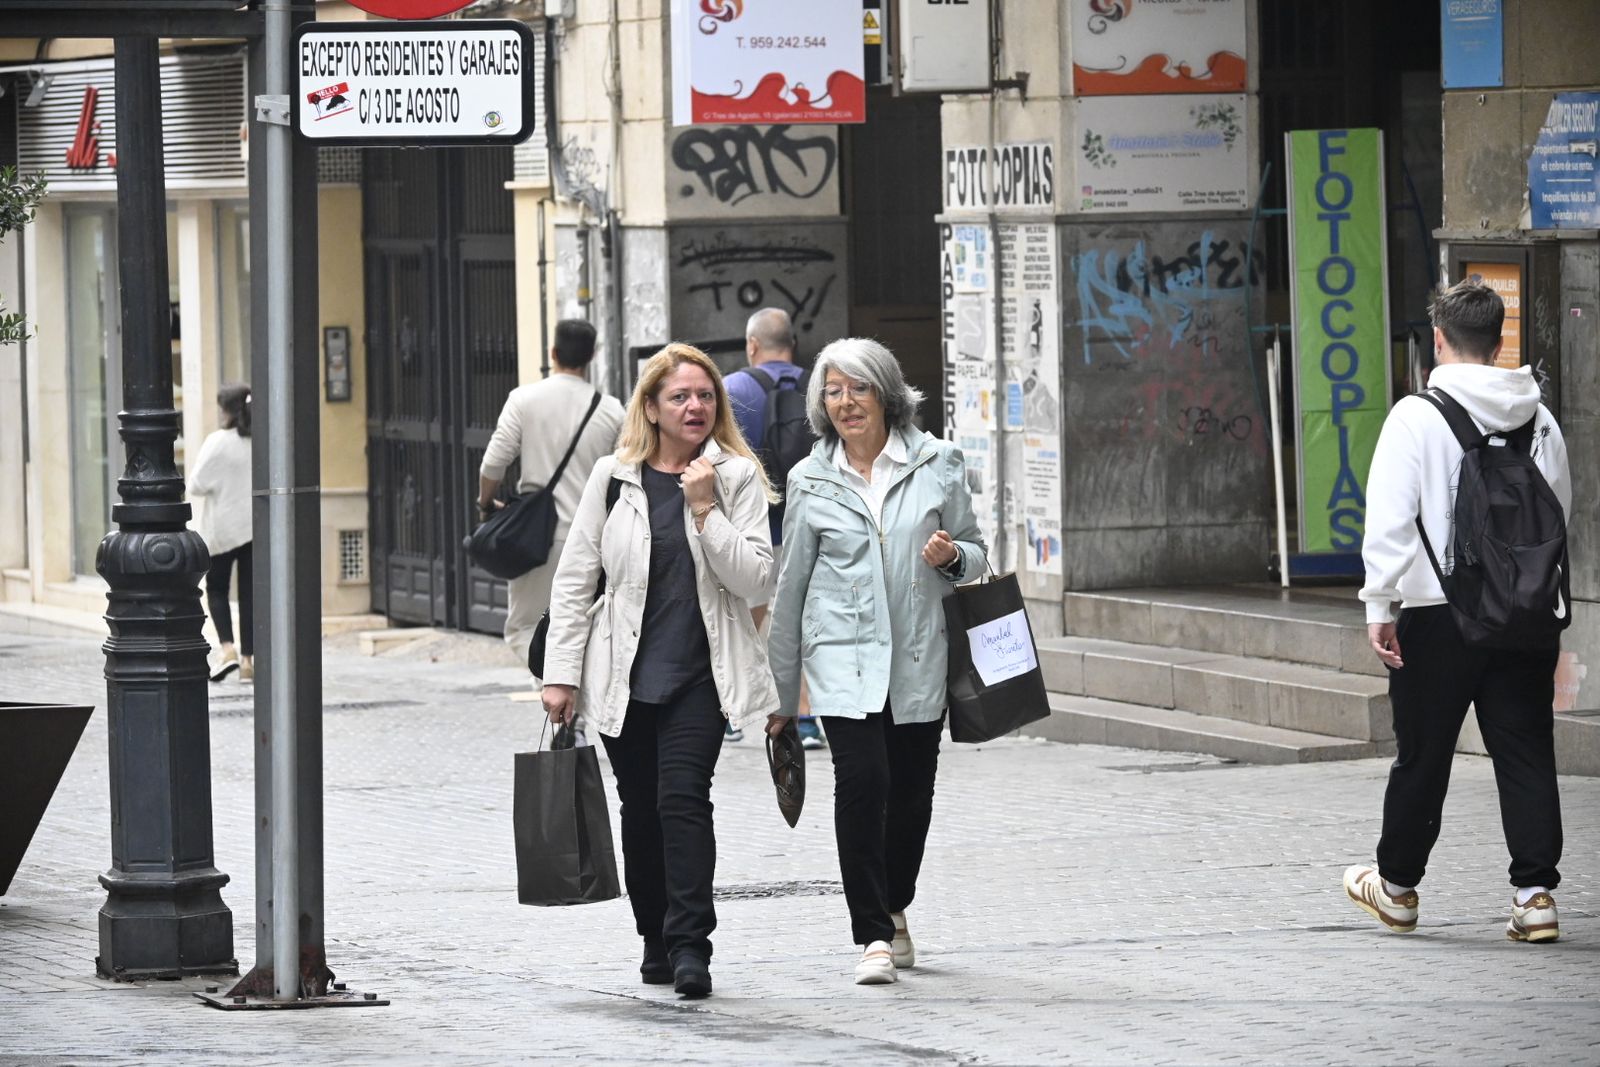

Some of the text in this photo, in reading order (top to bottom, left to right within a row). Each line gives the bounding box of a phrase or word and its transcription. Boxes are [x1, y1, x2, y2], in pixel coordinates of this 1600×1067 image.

[302, 39, 520, 77] EXCEPTO RESIDENTES Y GARAJES
[736, 36, 826, 49] T. 959.242.544
[359, 87, 460, 124] C/ 3 DE AGOSTO
[947, 146, 1053, 207] FOTOCOPIAS
[688, 273, 836, 335] TOY!
[1315, 130, 1366, 551] FOTOCOPIAS
